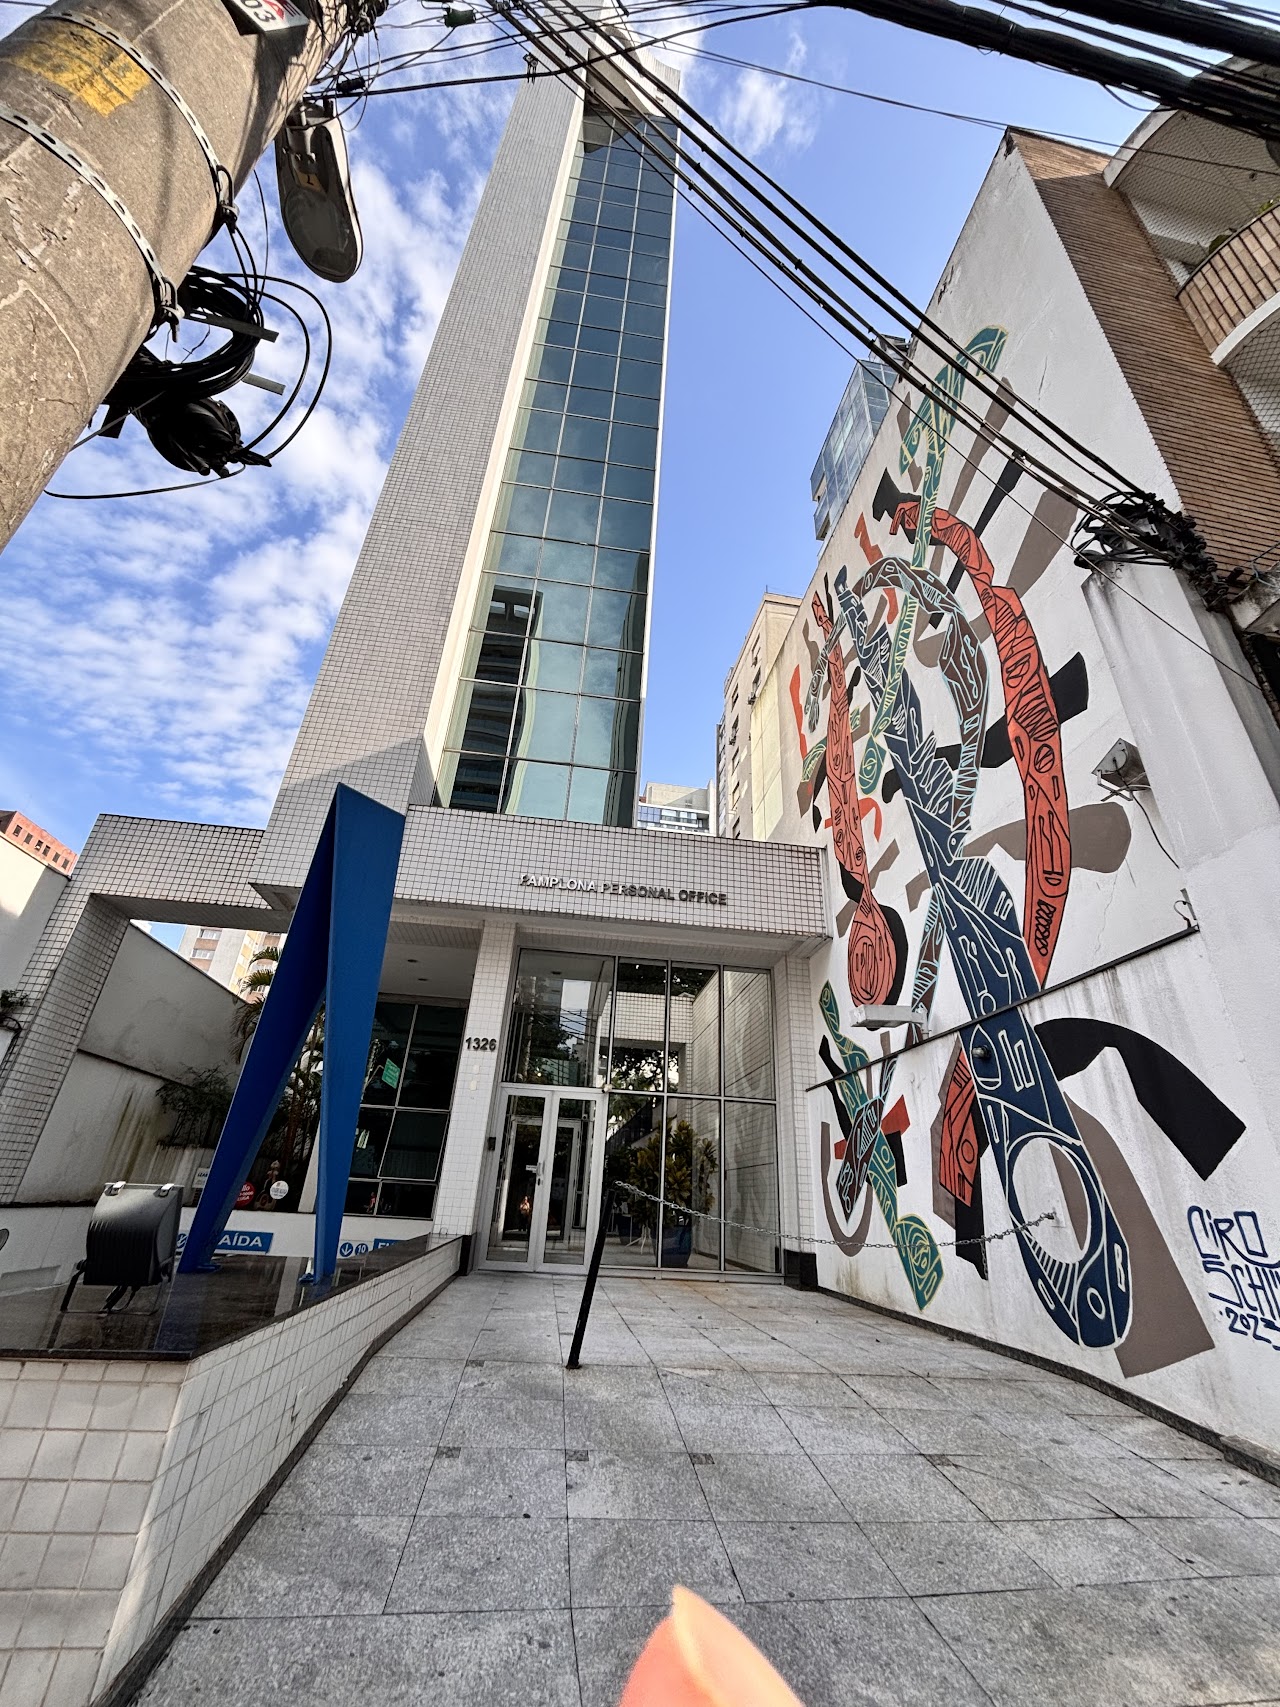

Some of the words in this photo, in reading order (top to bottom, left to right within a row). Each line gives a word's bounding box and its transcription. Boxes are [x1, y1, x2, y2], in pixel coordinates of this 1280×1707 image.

[520, 873, 597, 892] PAMPLONA
[600, 882, 675, 900] PERSONAL
[678, 889, 727, 906] OFFICE
[465, 1037, 497, 1052] 1326
[217, 1232, 263, 1248] AÍDA
